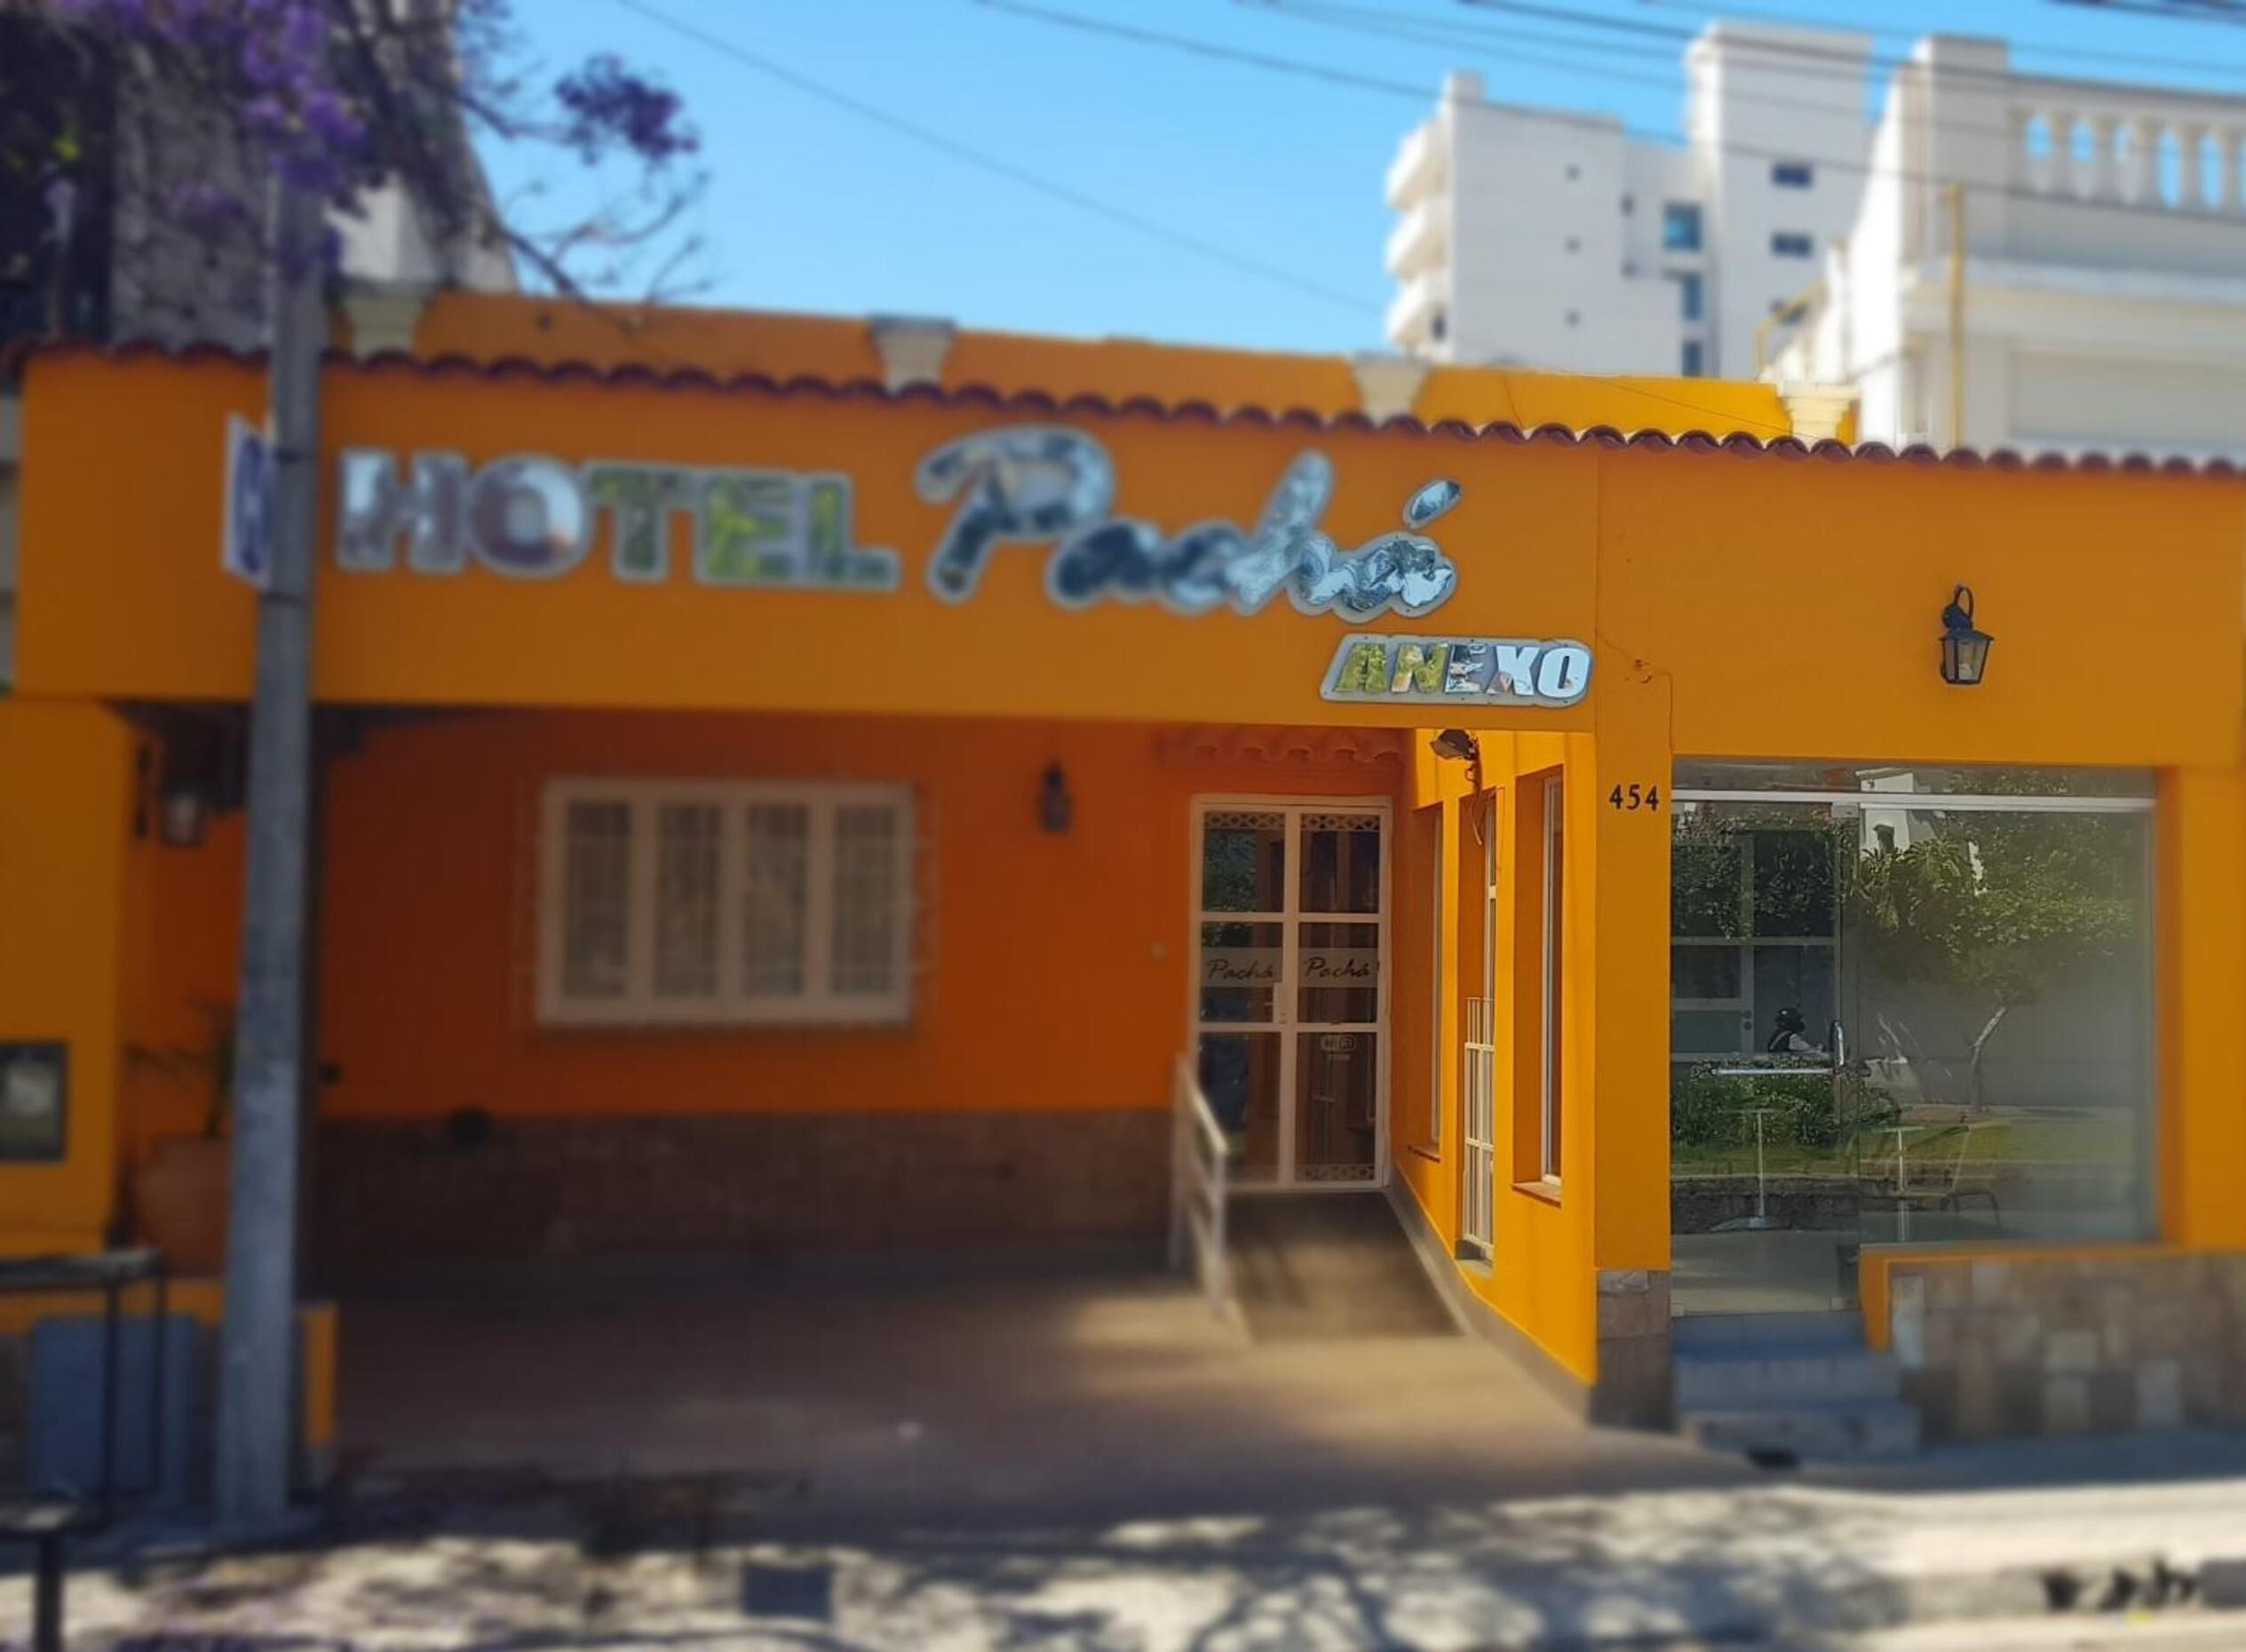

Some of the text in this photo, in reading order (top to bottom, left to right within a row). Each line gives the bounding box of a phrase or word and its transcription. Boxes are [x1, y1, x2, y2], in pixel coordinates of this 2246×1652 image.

[337, 426, 1462, 621] HOTEL Pachá
[1334, 642, 1591, 699] ANEXO
[1608, 784, 1660, 812] 454
